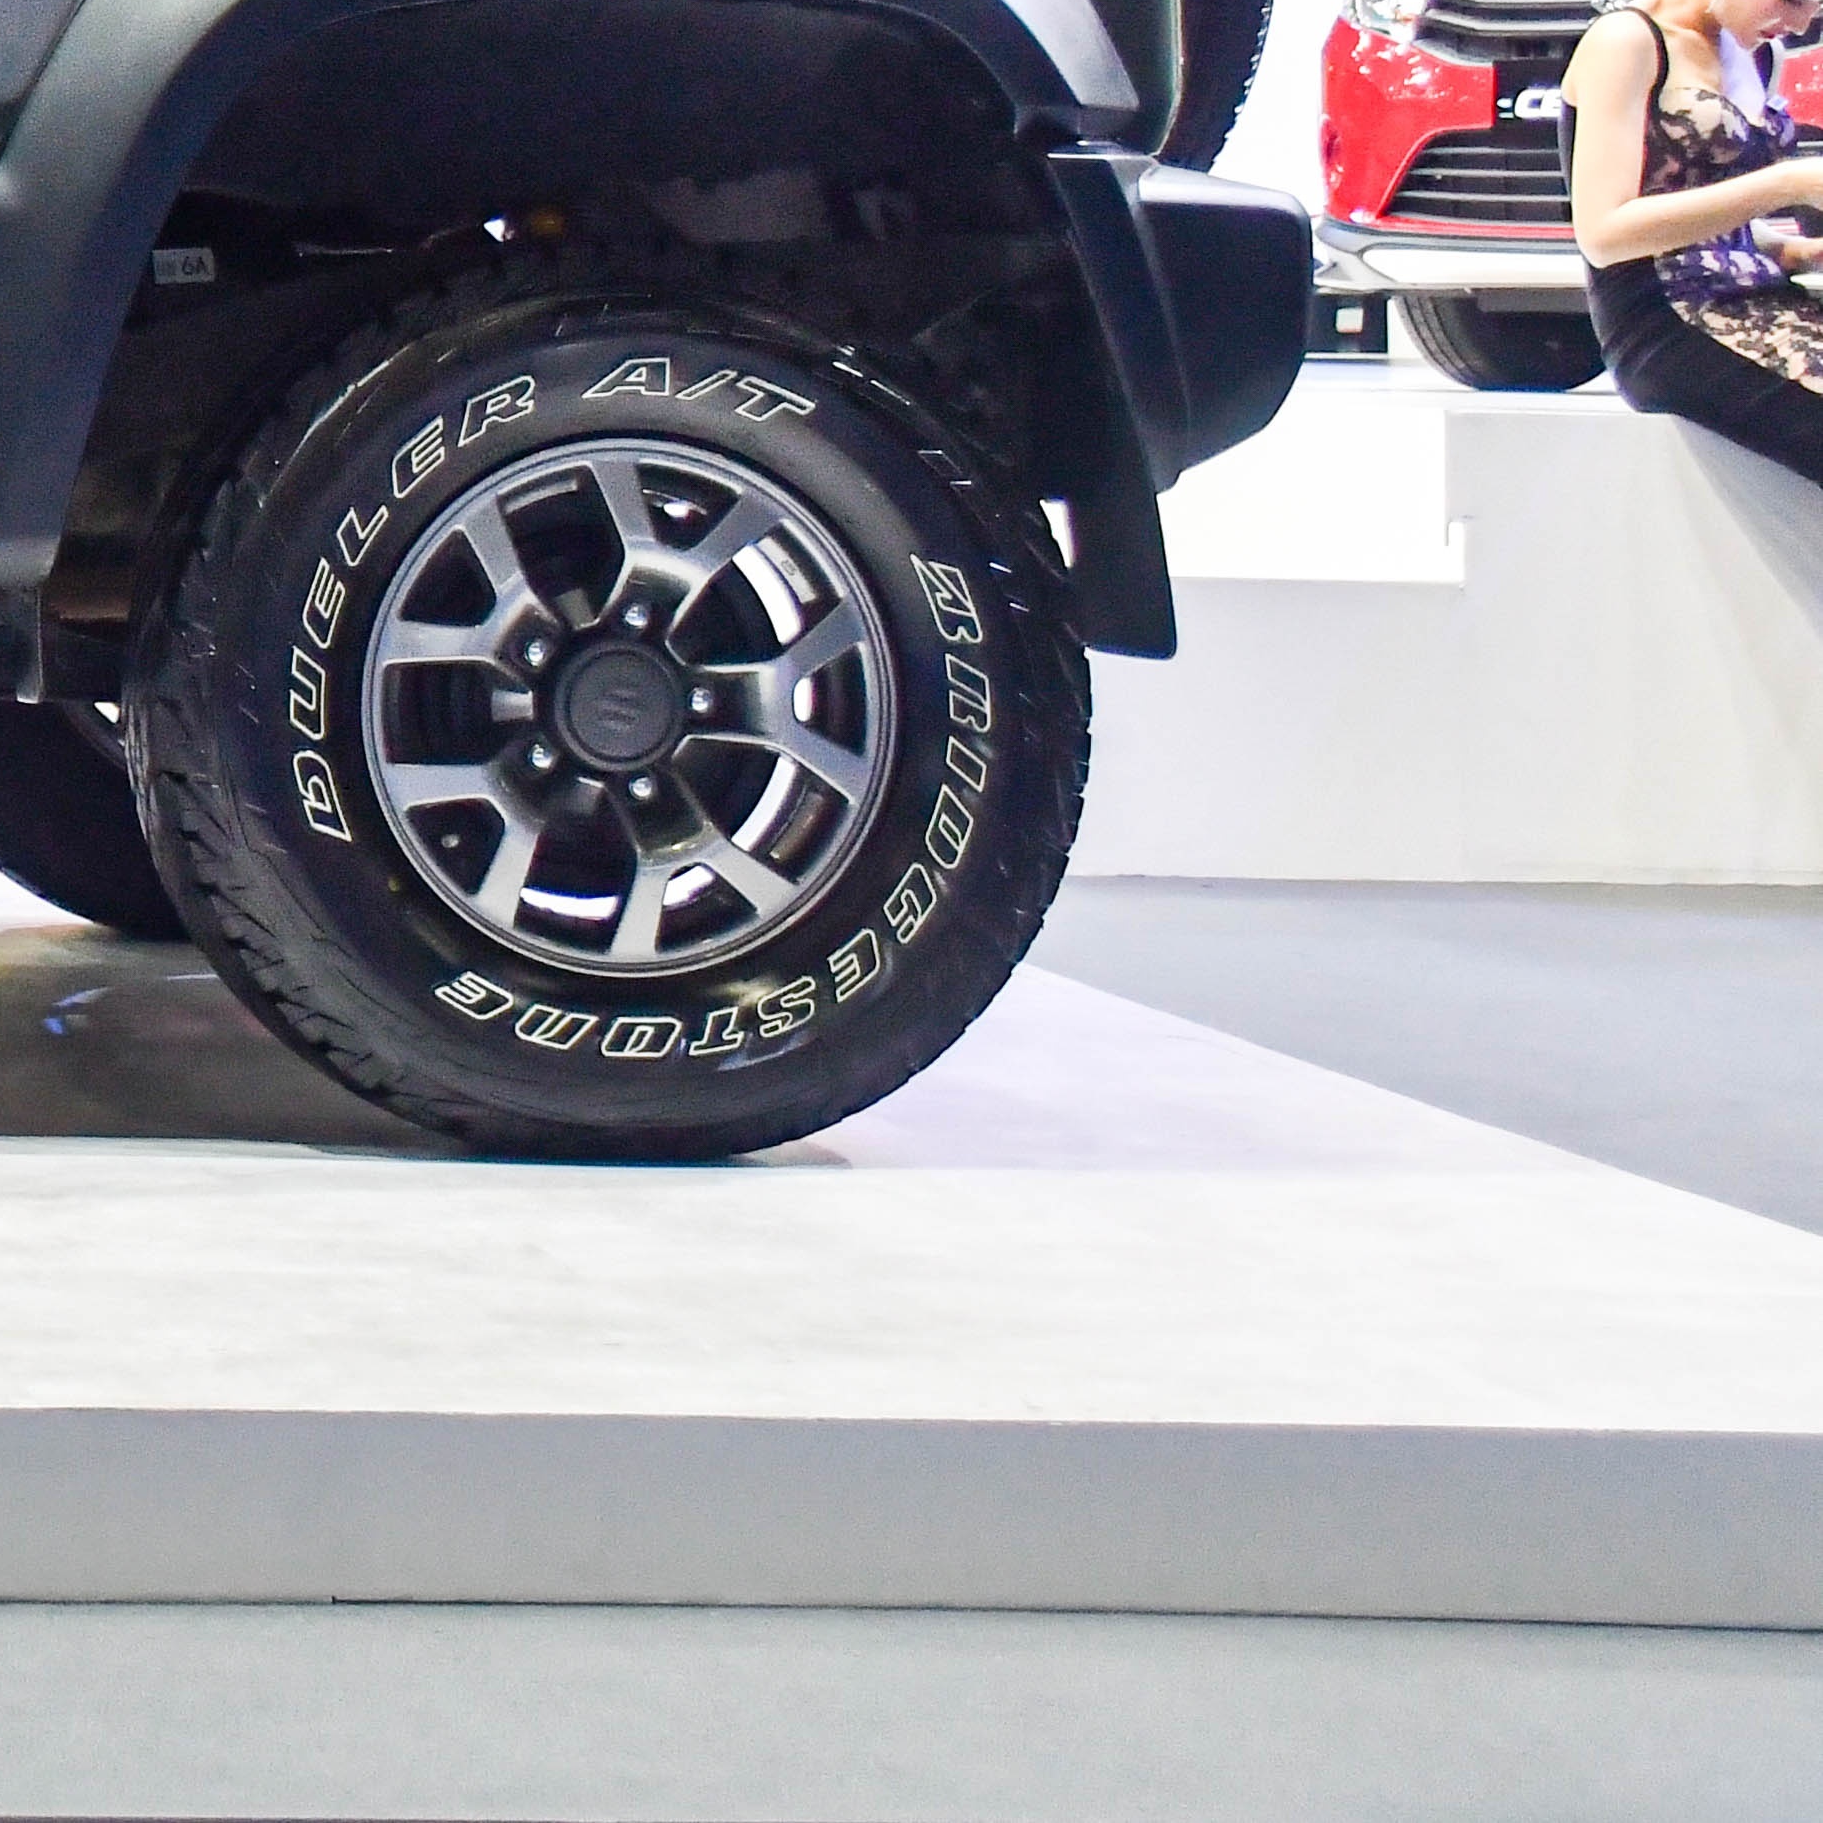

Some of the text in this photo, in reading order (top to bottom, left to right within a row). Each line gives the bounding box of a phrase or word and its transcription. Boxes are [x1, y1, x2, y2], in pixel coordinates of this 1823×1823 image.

[289, 356, 817, 843] DUELER A/T
[434, 553, 992, 1059] BRIDGESTONE
